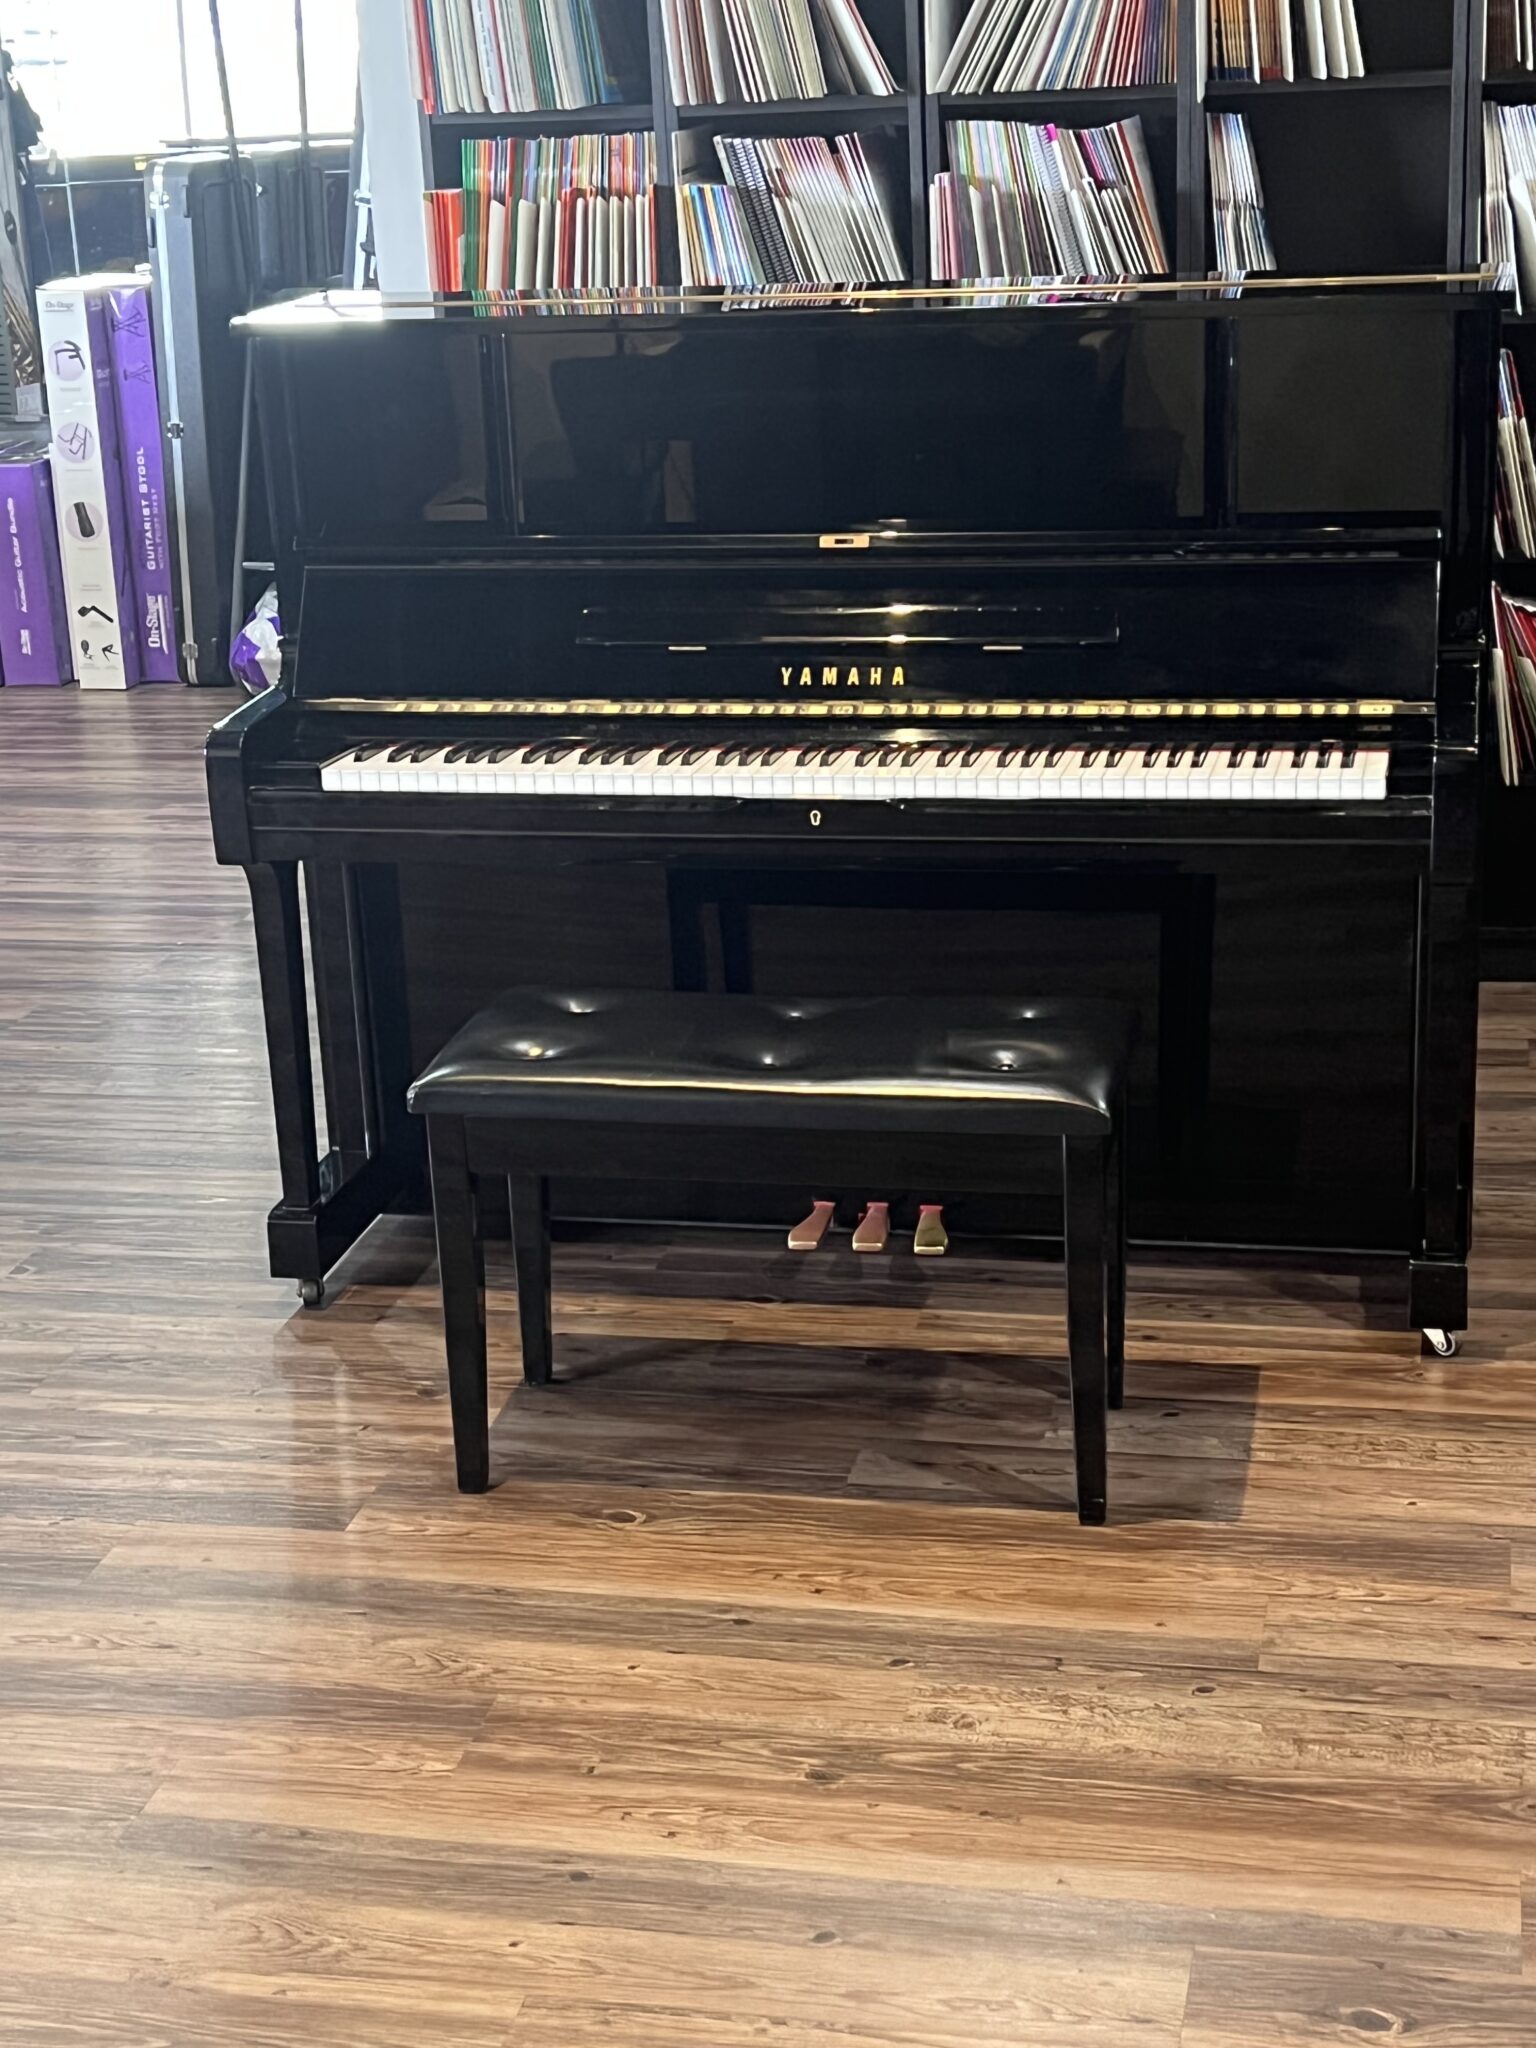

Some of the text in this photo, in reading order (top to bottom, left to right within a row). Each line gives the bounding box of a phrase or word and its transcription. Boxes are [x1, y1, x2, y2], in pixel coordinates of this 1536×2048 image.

[136, 447, 157, 571] GUITARIST STOOL
[146, 592, 161, 649] On-Stage
[781, 666, 905, 686] YAMAHA
